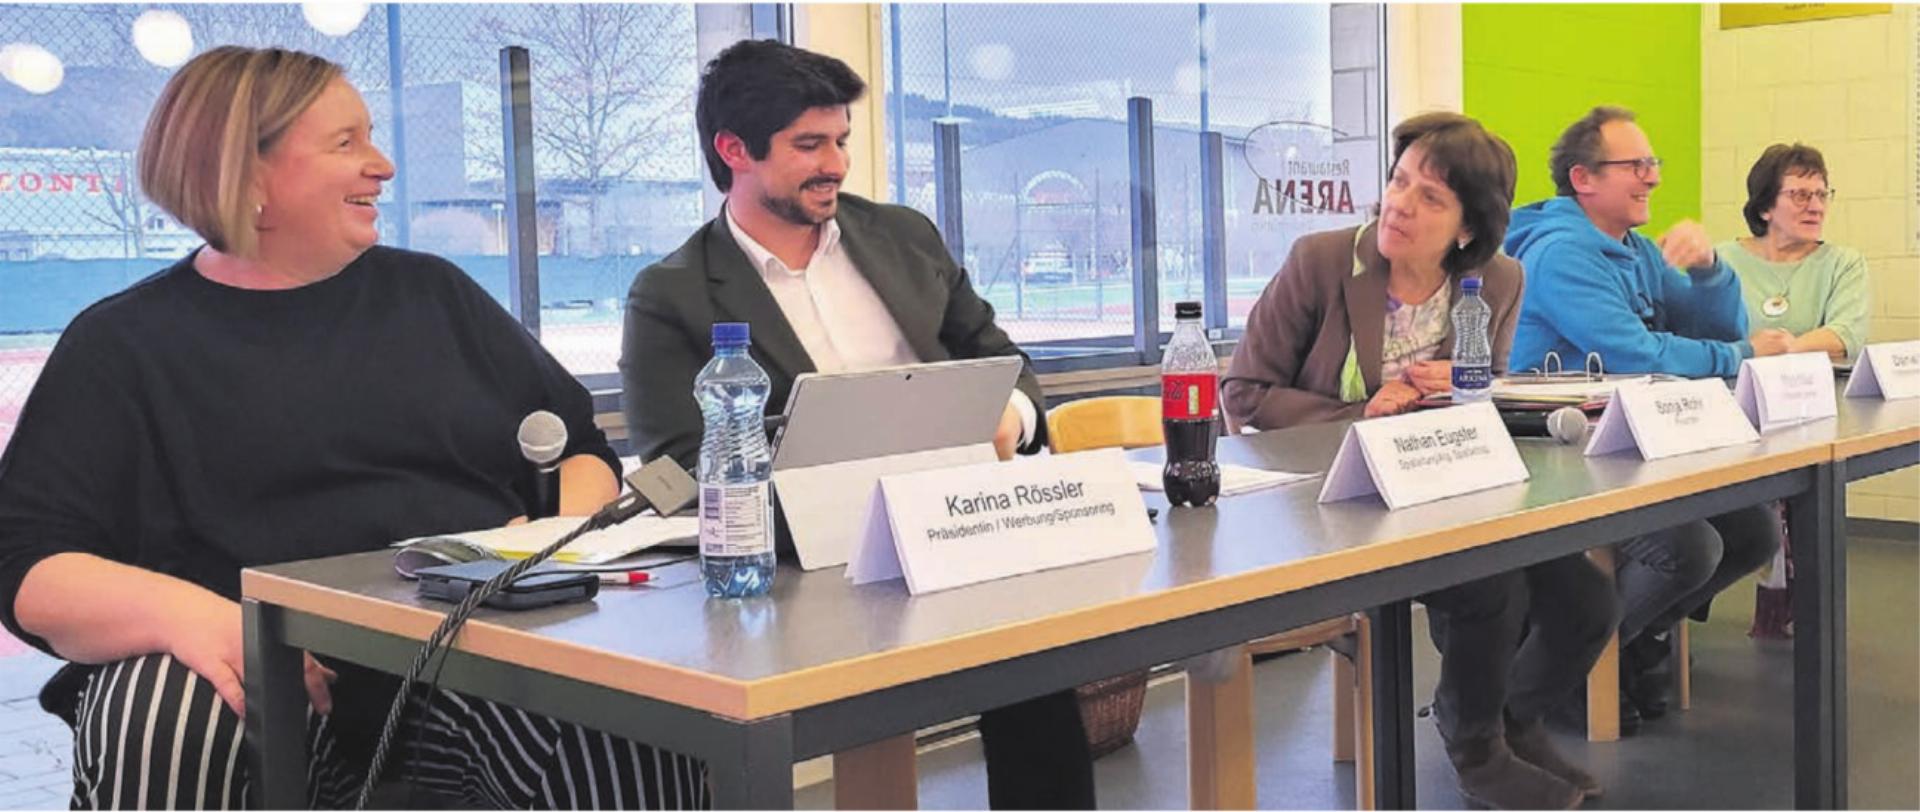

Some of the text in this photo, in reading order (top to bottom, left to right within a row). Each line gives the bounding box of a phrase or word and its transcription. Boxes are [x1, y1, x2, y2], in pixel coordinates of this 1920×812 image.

[1393, 426, 1478, 454] Nathan Eugster
[945, 480, 1085, 517] Karina Rössler
[927, 520, 995, 542] Präsidentin
[1003, 501, 1116, 530] Werbung/Sponsoring
